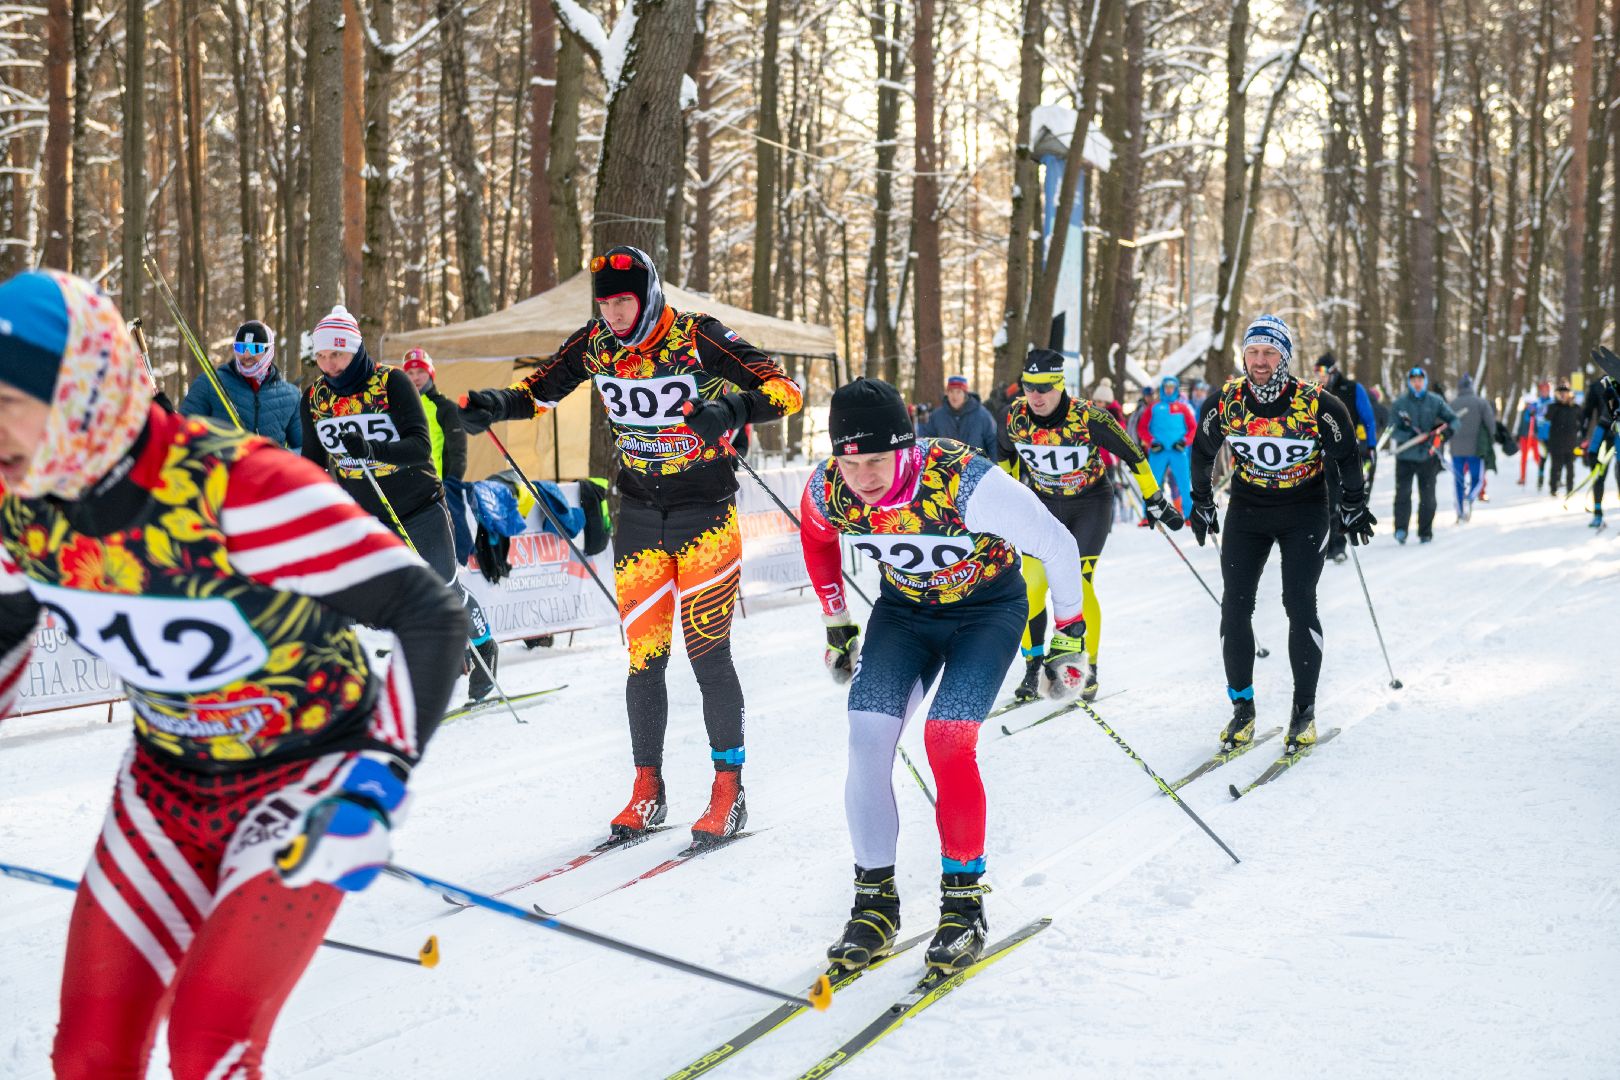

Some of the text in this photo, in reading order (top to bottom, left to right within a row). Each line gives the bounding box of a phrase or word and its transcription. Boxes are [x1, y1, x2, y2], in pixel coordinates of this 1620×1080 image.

[602, 381, 691, 418] 302
[621, 437, 690, 453] volkuscha.ru
[1020, 449, 1079, 470] 311
